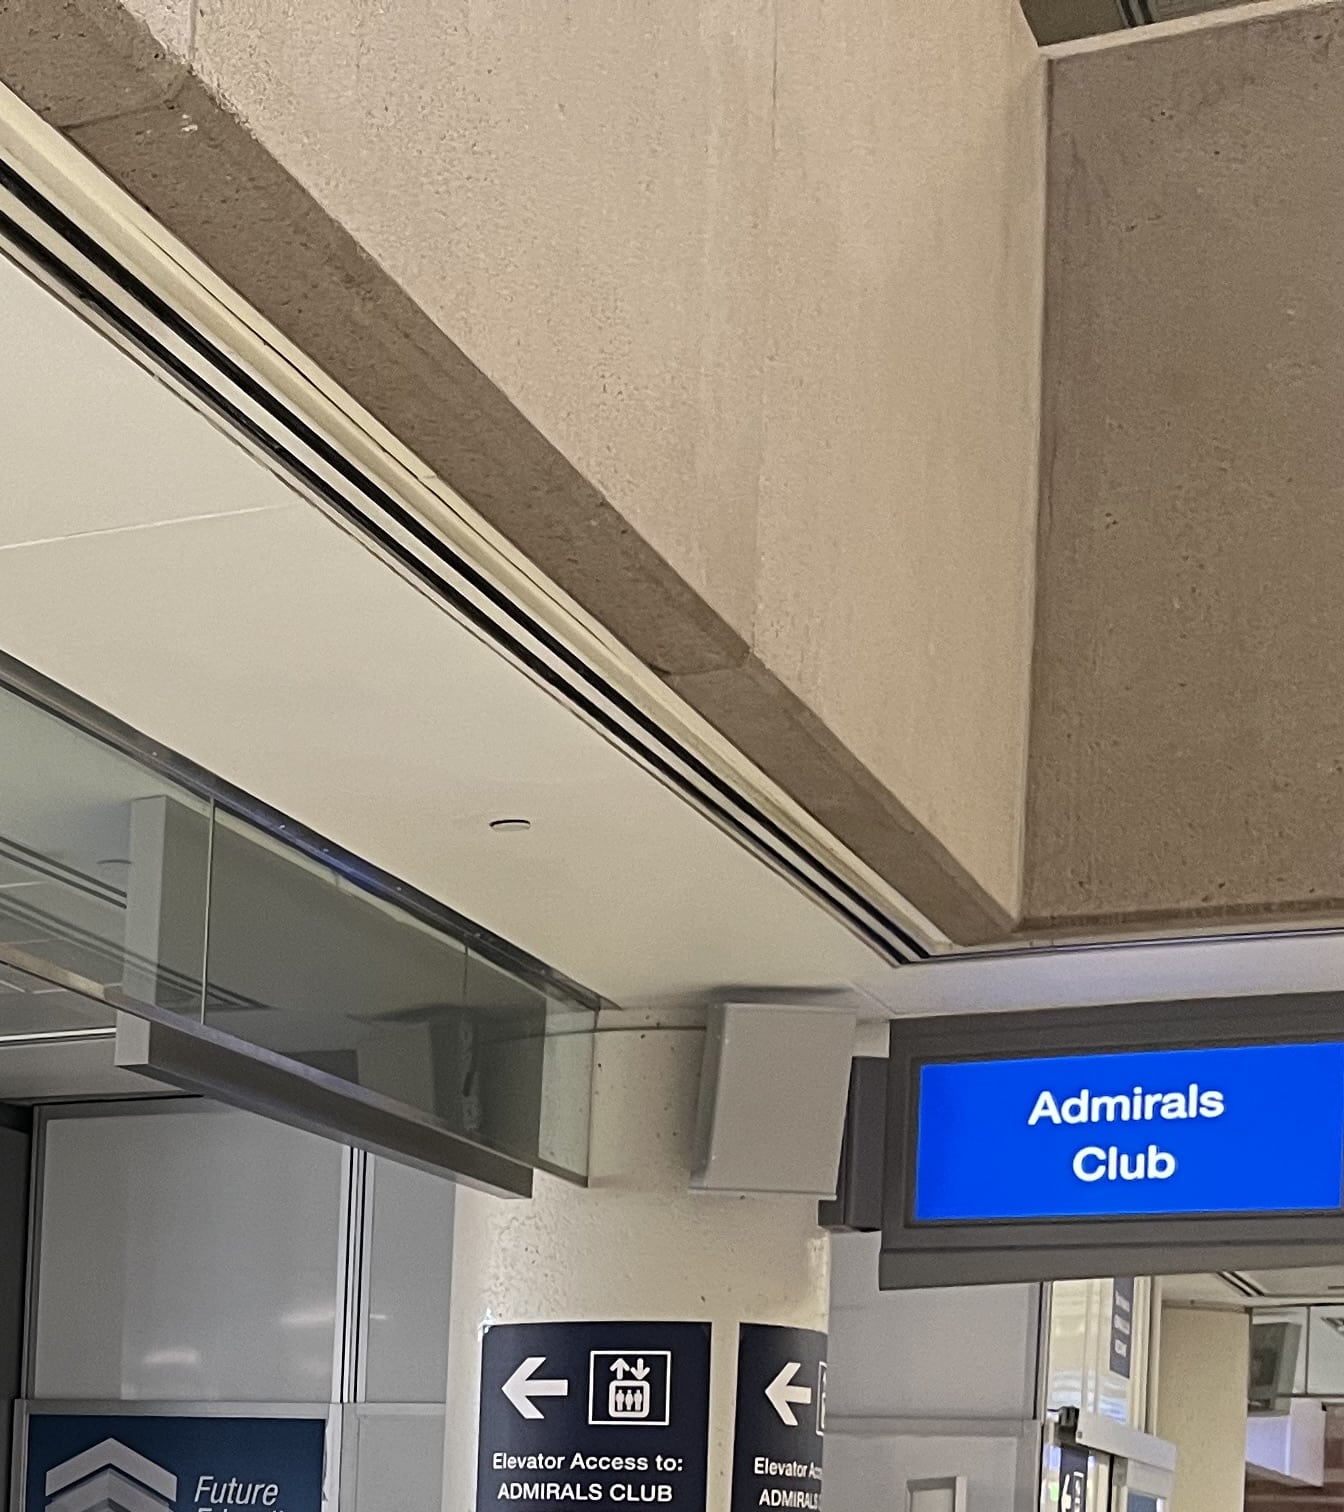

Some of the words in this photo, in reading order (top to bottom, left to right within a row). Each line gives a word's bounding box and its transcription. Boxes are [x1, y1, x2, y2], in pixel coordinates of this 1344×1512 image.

[1028, 1083, 1225, 1126] Admirals
[1072, 1144, 1176, 1182] Club
[493, 1452, 565, 1470] Elevator
[570, 1452, 648, 1471] Access
[656, 1454, 683, 1471] to:
[754, 1456, 808, 1478] Elevator
[194, 1475, 279, 1506] Future
[497, 1483, 602, 1501] ADMIRALS
[610, 1483, 673, 1502] CLUB
